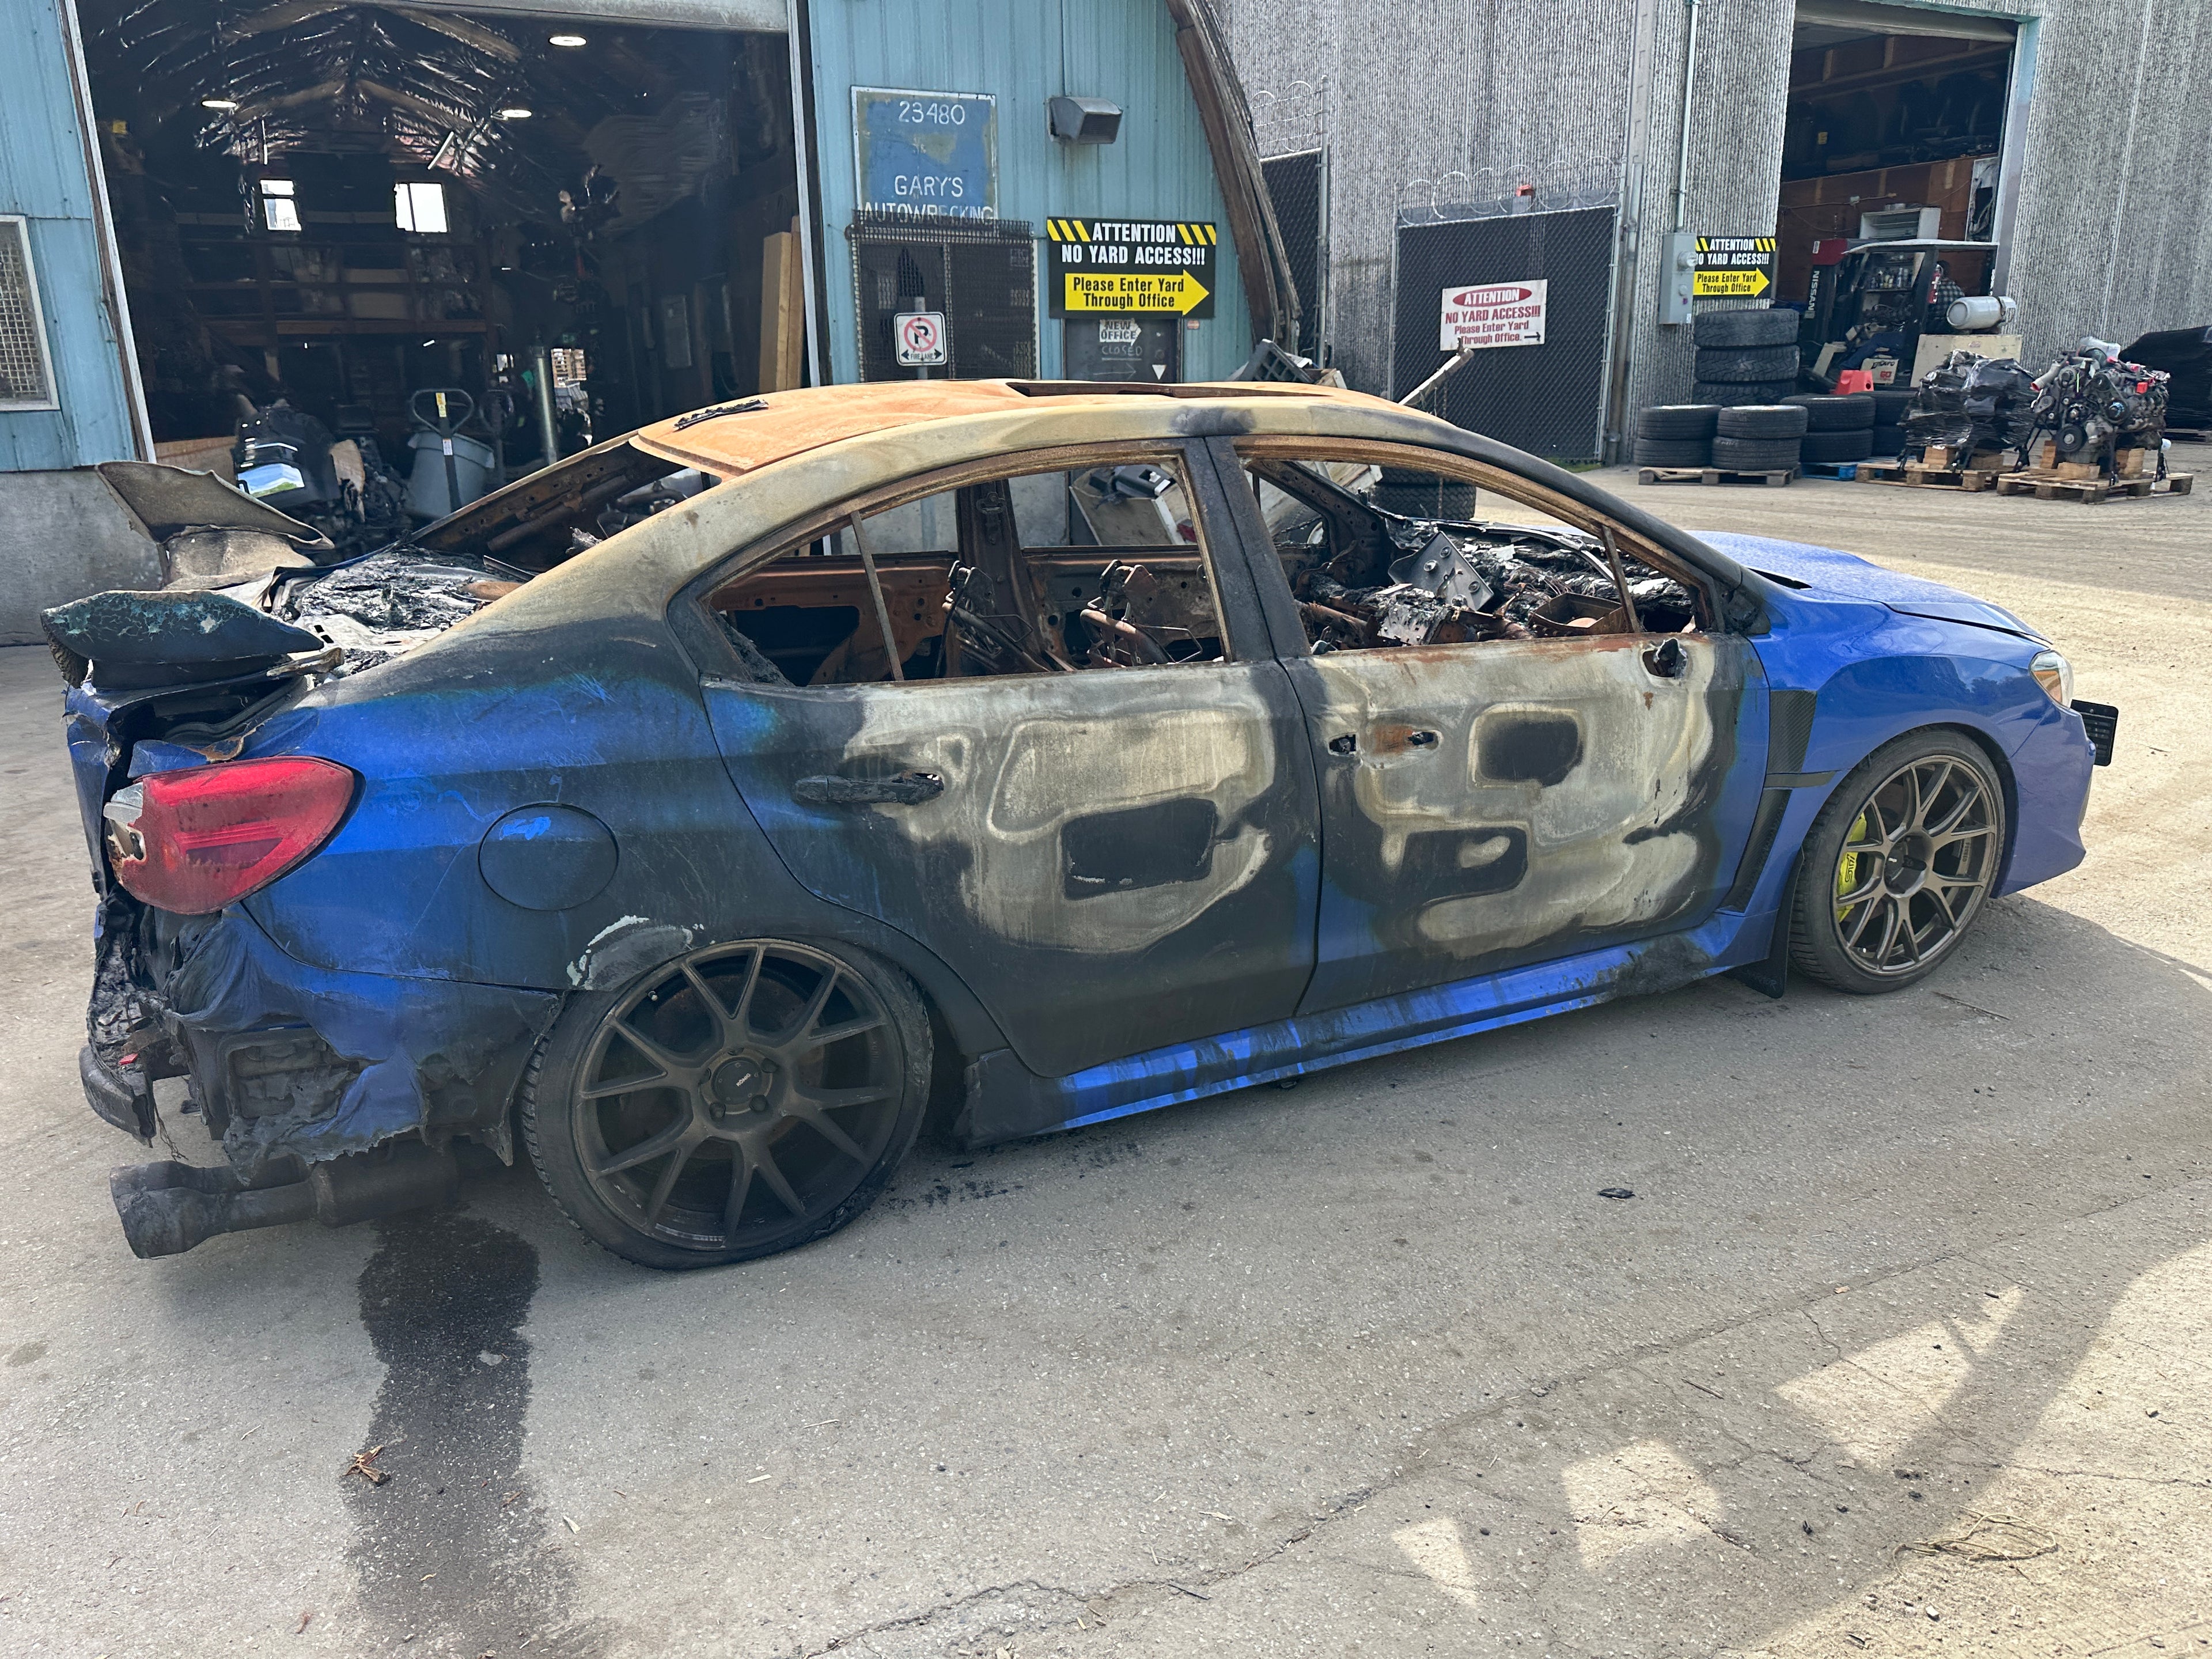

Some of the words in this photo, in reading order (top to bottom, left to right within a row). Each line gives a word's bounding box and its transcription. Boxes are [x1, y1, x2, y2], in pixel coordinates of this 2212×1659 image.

[899, 100, 965, 125] 23480
[895, 175, 963, 198] GARY'S
[1092, 222, 1176, 243] ATTENTION
[1709, 238, 1755, 251] ATTENTION
[1062, 244, 1082, 263] NO
[1089, 245, 1128, 264] YARD
[1134, 247, 1205, 266] ACCESS!!!
[1707, 253, 1728, 265] YARD
[1730, 253, 1770, 265] ACCESS!!!
[1073, 276, 1113, 292] Please
[1120, 278, 1153, 292] Enter
[1158, 278, 1184, 293] Yard
[1697, 273, 1719, 283] Please
[1722, 273, 1740, 283] Enter
[1742, 272, 1757, 282] Yard
[1702, 283, 1729, 294] Through
[1731, 283, 1751, 292] Office
[1808, 270, 1820, 310] NISSAN
[1084, 293, 1133, 309] Through
[1139, 294, 1175, 308] Office
[1464, 288, 1520, 305] ATTENTION
[1445, 311, 1459, 324] NO
[1461, 309, 1488, 323] YARD
[1491, 305, 1541, 320] ACCESS!!!
[1105, 320, 1131, 330] NEW
[1455, 324, 1480, 335] Please
[1482, 323, 1506, 333] Enter
[1508, 320, 1529, 331] Yard
[1101, 329, 1137, 340] OFFICE
[1461, 334, 1492, 345] Through
[1101, 344, 1143, 357] CLOSED
